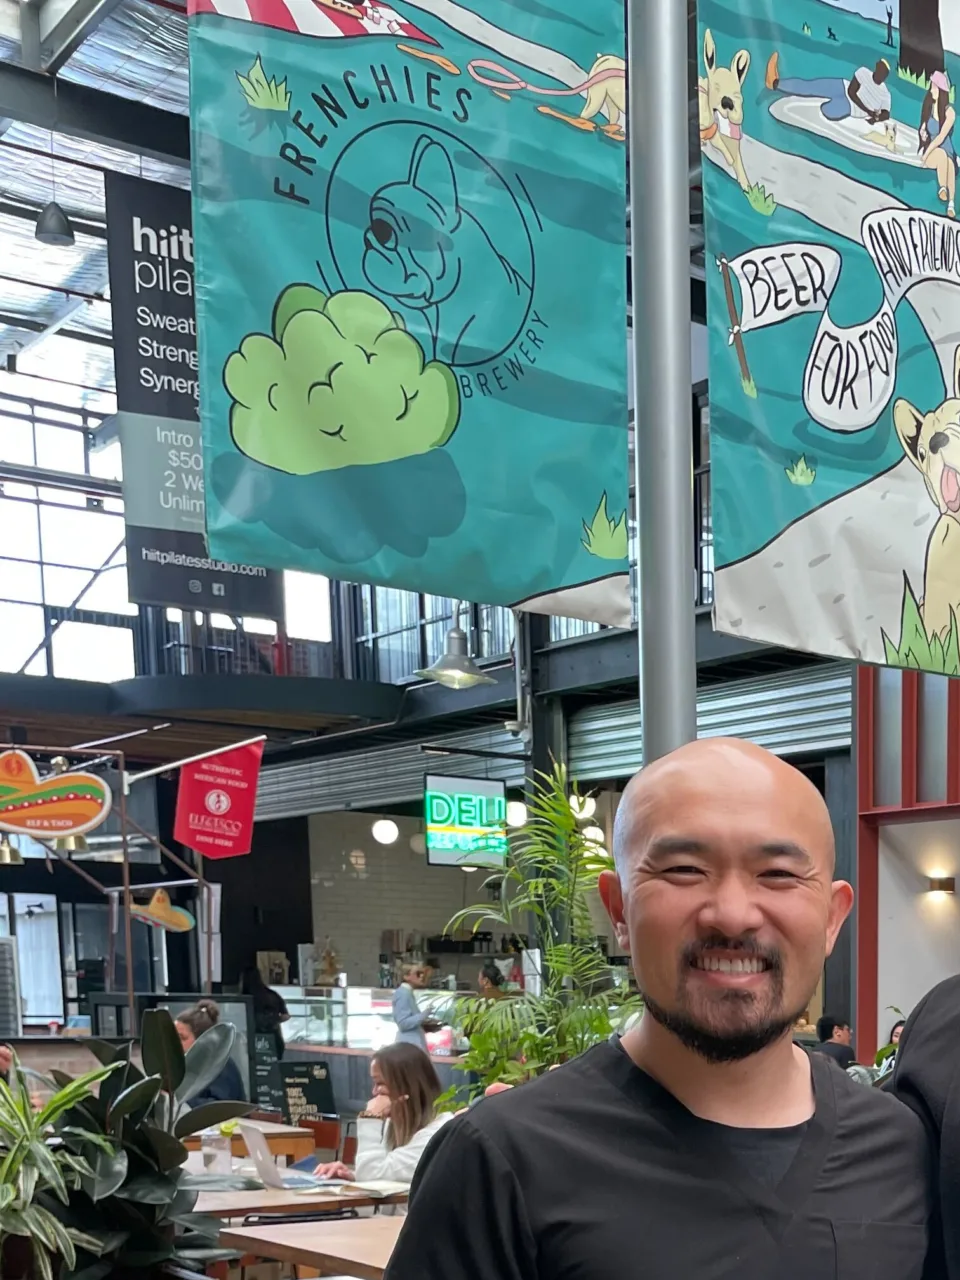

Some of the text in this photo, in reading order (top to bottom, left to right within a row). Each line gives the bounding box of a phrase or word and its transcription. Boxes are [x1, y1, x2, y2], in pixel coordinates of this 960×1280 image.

[274, 63, 473, 205] FRENCHIES
[132, 216, 194, 263] hiit
[134, 256, 195, 297] pila
[741, 252, 829, 319] BEER
[460, 309, 549, 399] BREWERY
[807, 311, 896, 411] FOR FOOD
[156, 426, 194, 448] Intro
[164, 470, 177, 488] 2
[141, 547, 267, 578] hiitpilatesstudio.com
[426, 791, 506, 829] DELI
